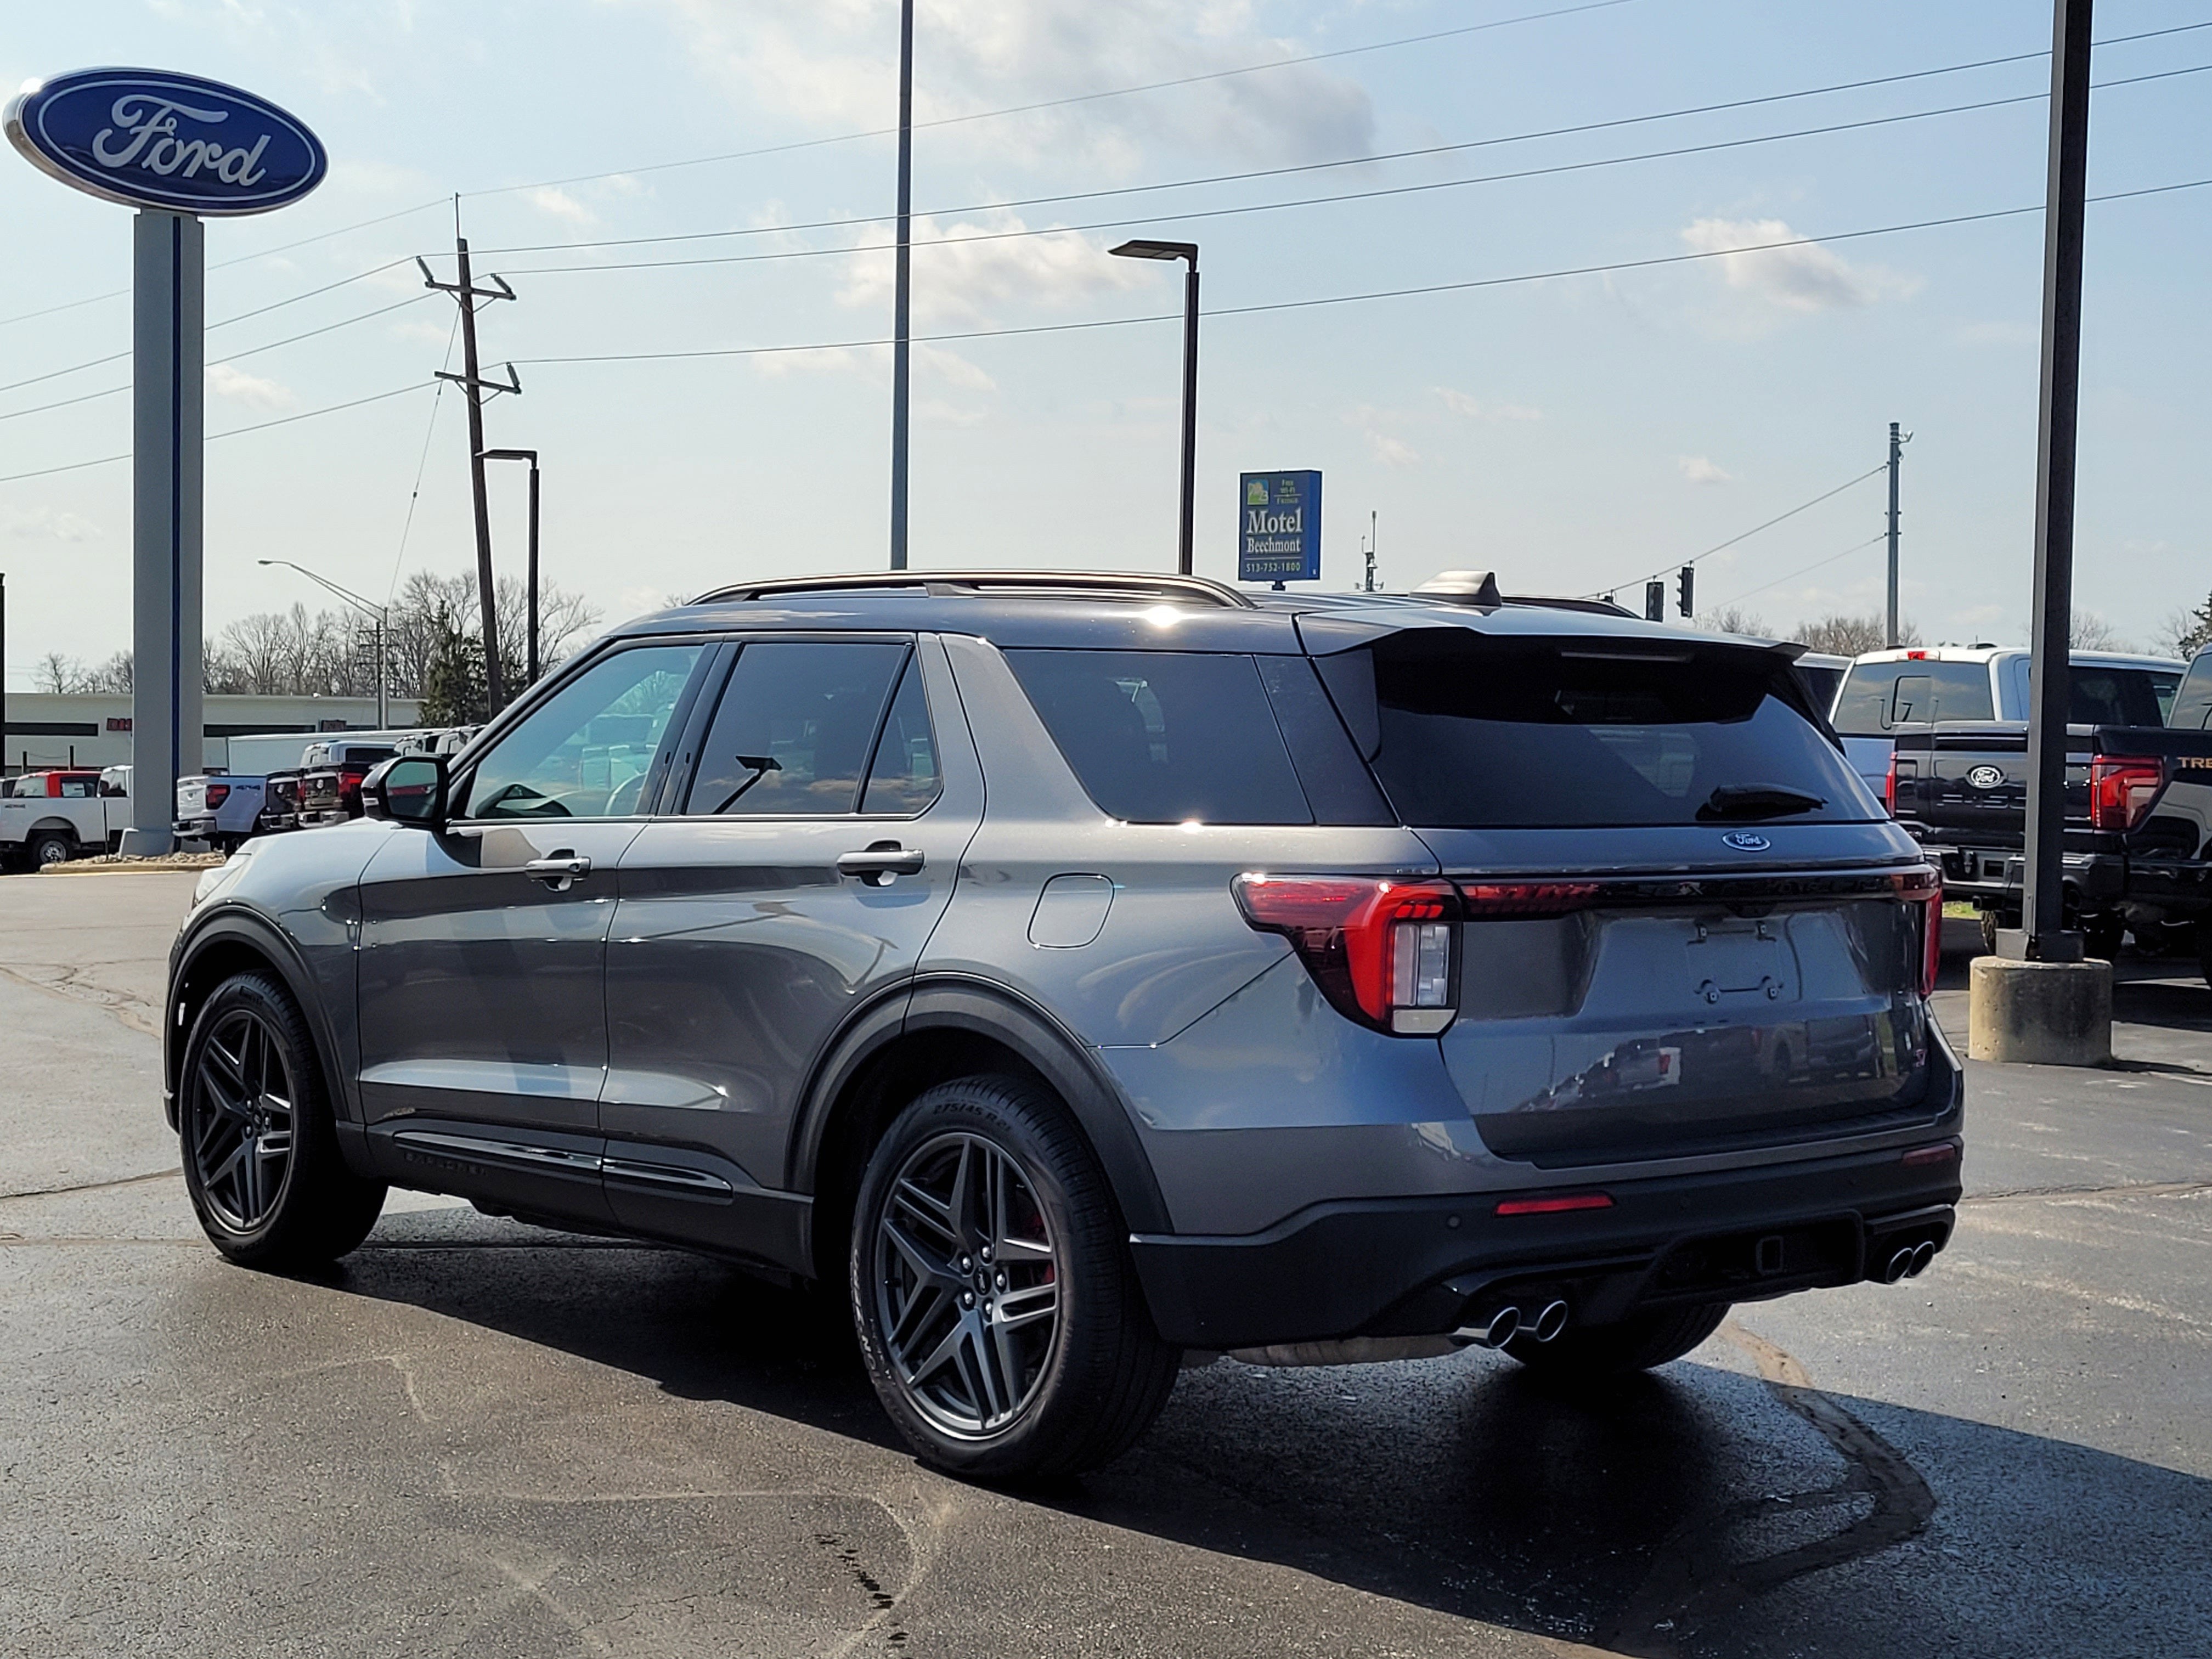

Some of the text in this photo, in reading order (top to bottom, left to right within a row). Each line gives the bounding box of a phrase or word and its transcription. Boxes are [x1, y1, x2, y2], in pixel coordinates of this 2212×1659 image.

[92, 94, 272, 187] Ford
[1246, 507, 1303, 534] Motel
[1247, 536, 1301, 554] Beechmont
[1735, 833, 1762, 844] Ford
